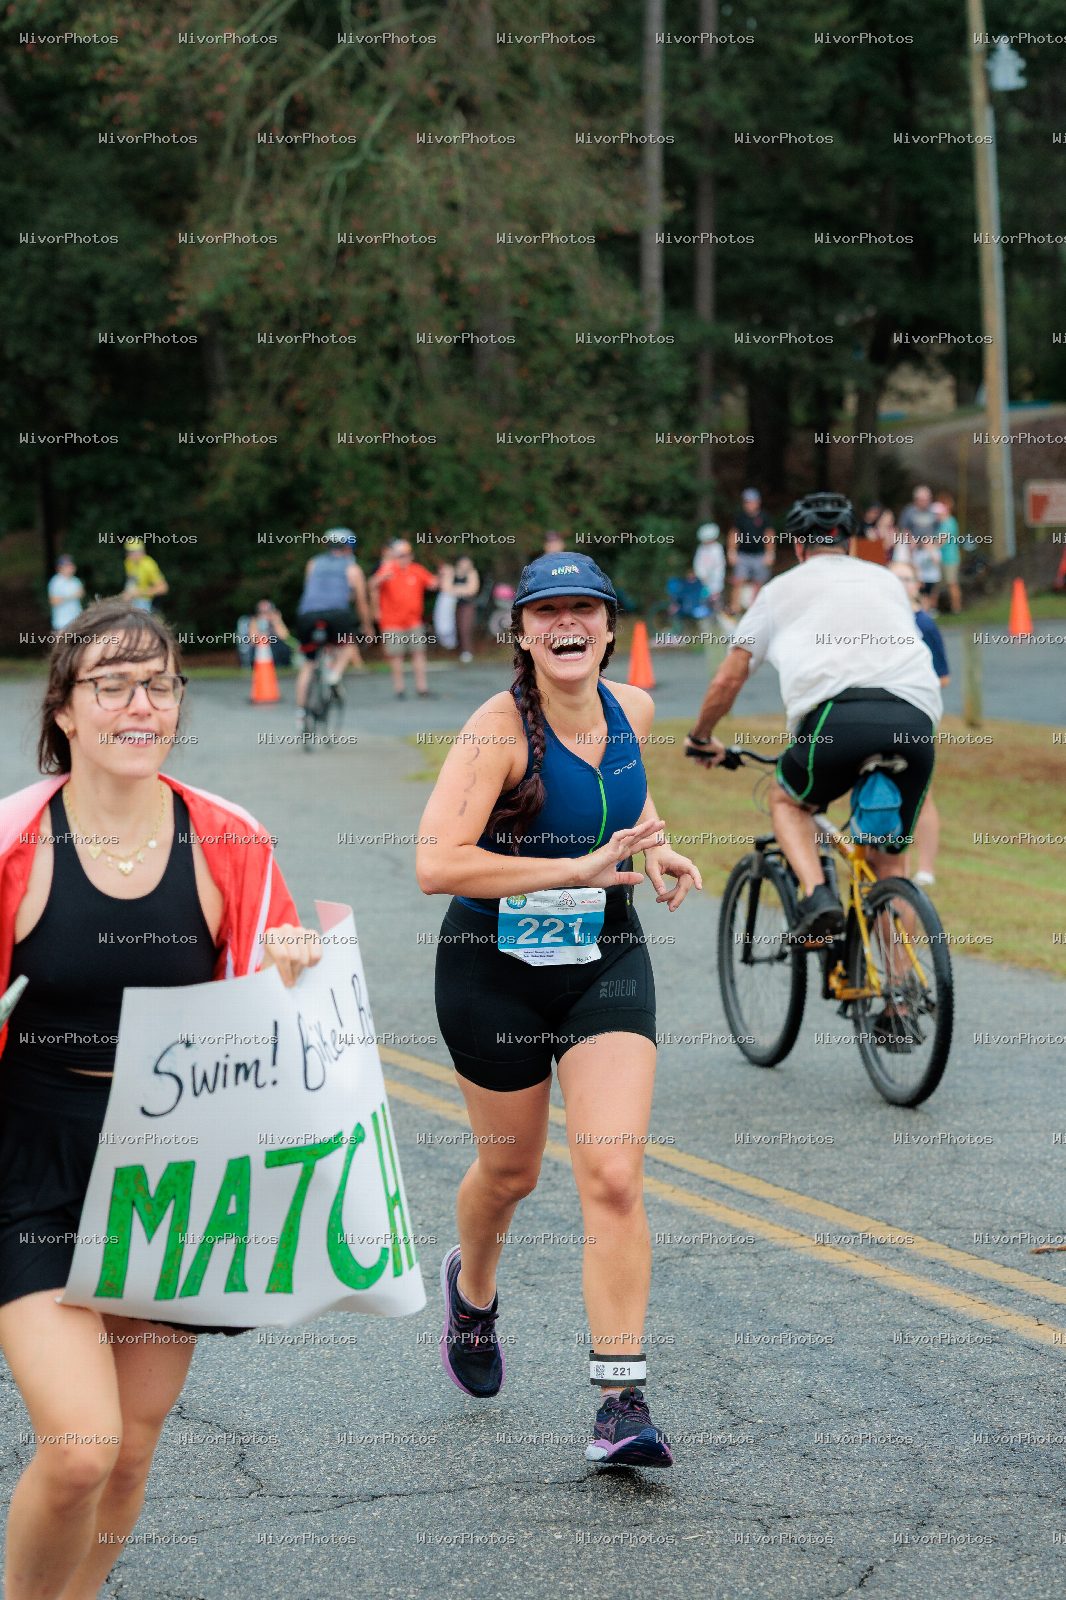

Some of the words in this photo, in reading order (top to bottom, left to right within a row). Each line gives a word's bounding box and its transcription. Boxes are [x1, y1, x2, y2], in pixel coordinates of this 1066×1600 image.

[613, 759, 637, 775] orca
[516, 917, 583, 944] 221
[608, 979, 637, 998] COEUR
[140, 1020, 278, 1118] Swim!
[95, 1102, 418, 1301] MATCH
[612, 1367, 632, 1376] 221
